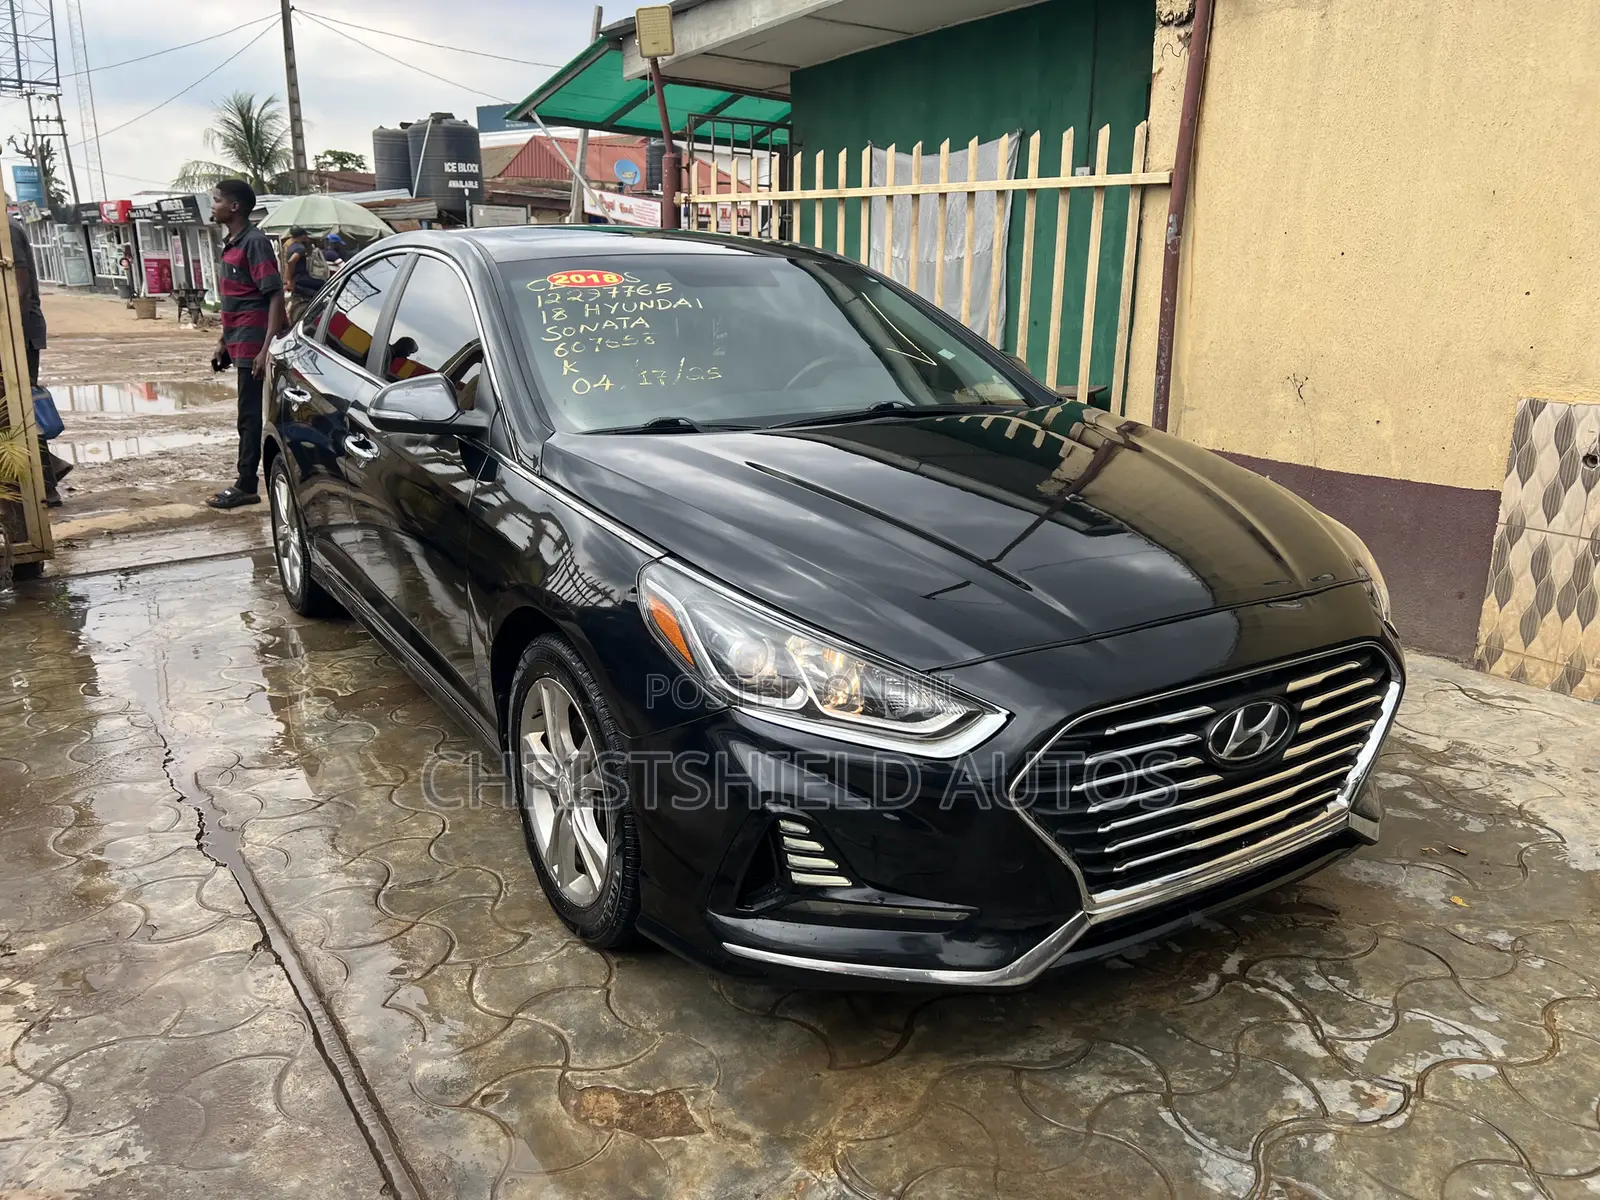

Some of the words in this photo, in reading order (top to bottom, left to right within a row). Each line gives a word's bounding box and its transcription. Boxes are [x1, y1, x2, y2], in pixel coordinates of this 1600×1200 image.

[444, 162, 457, 173] ICE
[457, 162, 479, 174] BLOCK
[448, 180, 479, 189] AVAILABLE
[553, 273, 620, 284] 2018
[541, 307, 568, 324] 18
[584, 297, 704, 317] HYUNDAI
[541, 316, 651, 341] SONATA
[562, 360, 580, 376] K
